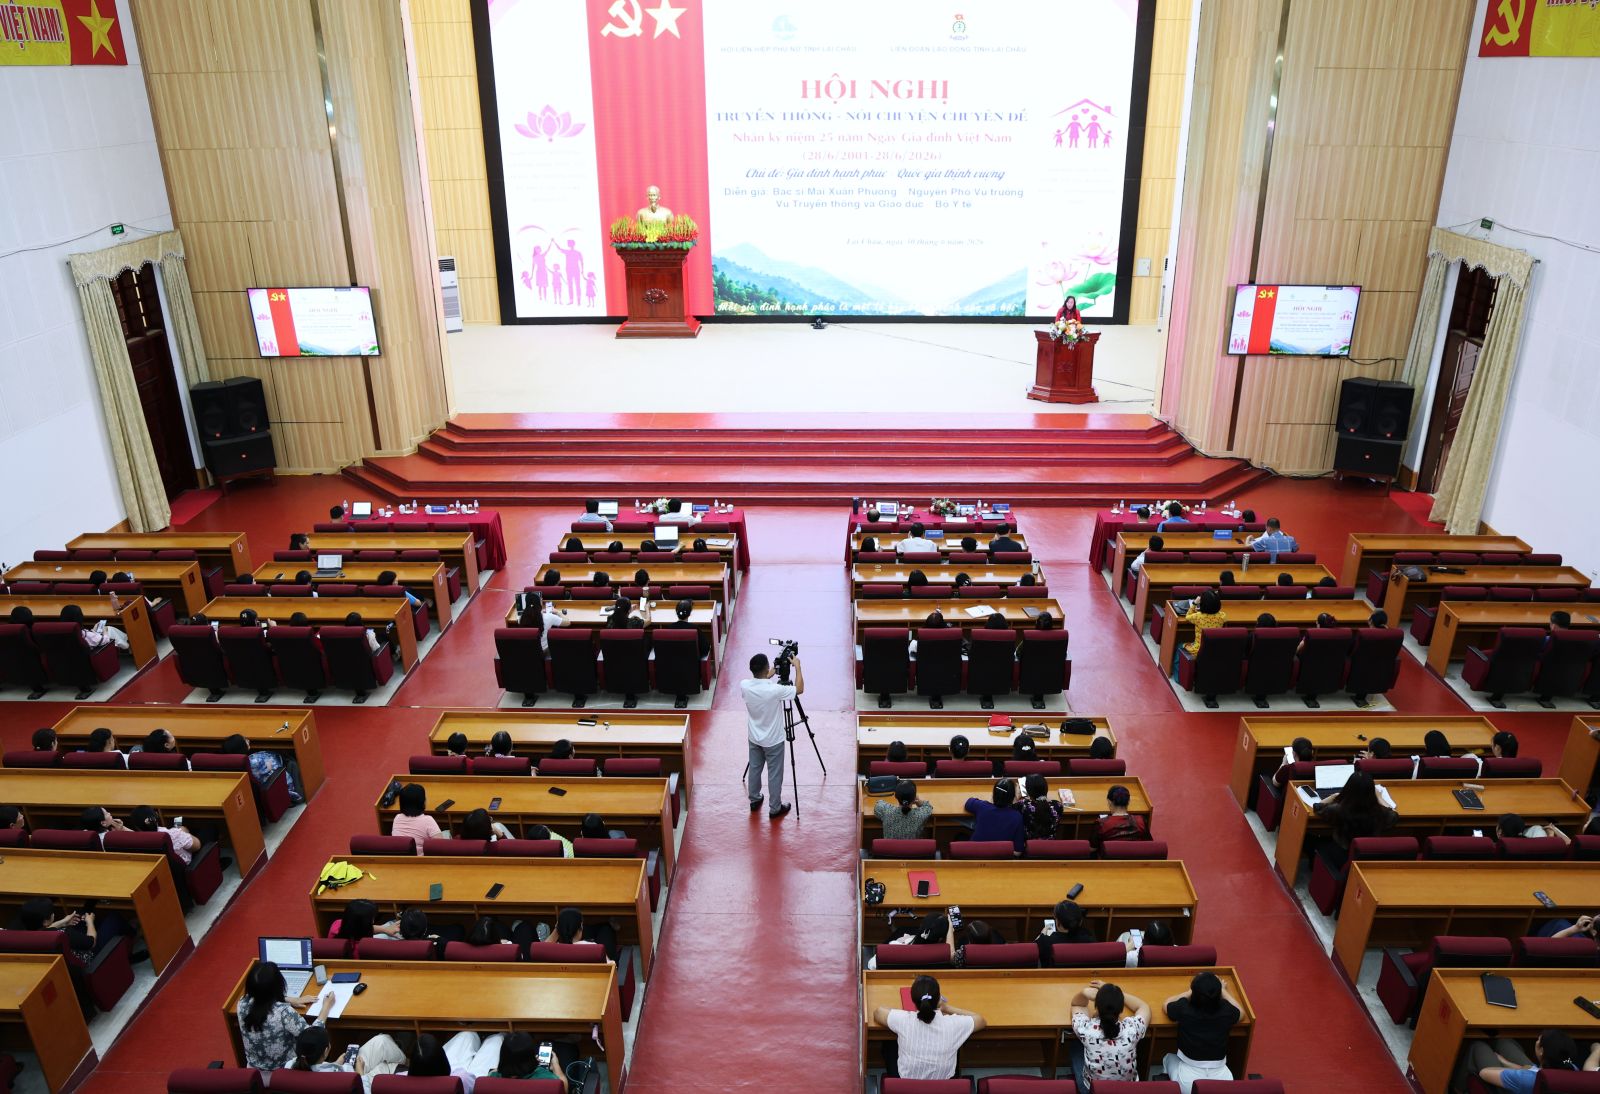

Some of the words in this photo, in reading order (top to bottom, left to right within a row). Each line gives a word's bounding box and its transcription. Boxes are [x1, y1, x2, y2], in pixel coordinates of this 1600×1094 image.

[27, 7, 65, 42] NAM!
[800, 73, 857, 104] HỘI
[870, 79, 949, 104] NGHỊ
[984, 133, 1012, 143] Nam
[807, 187, 825, 196] Mai
